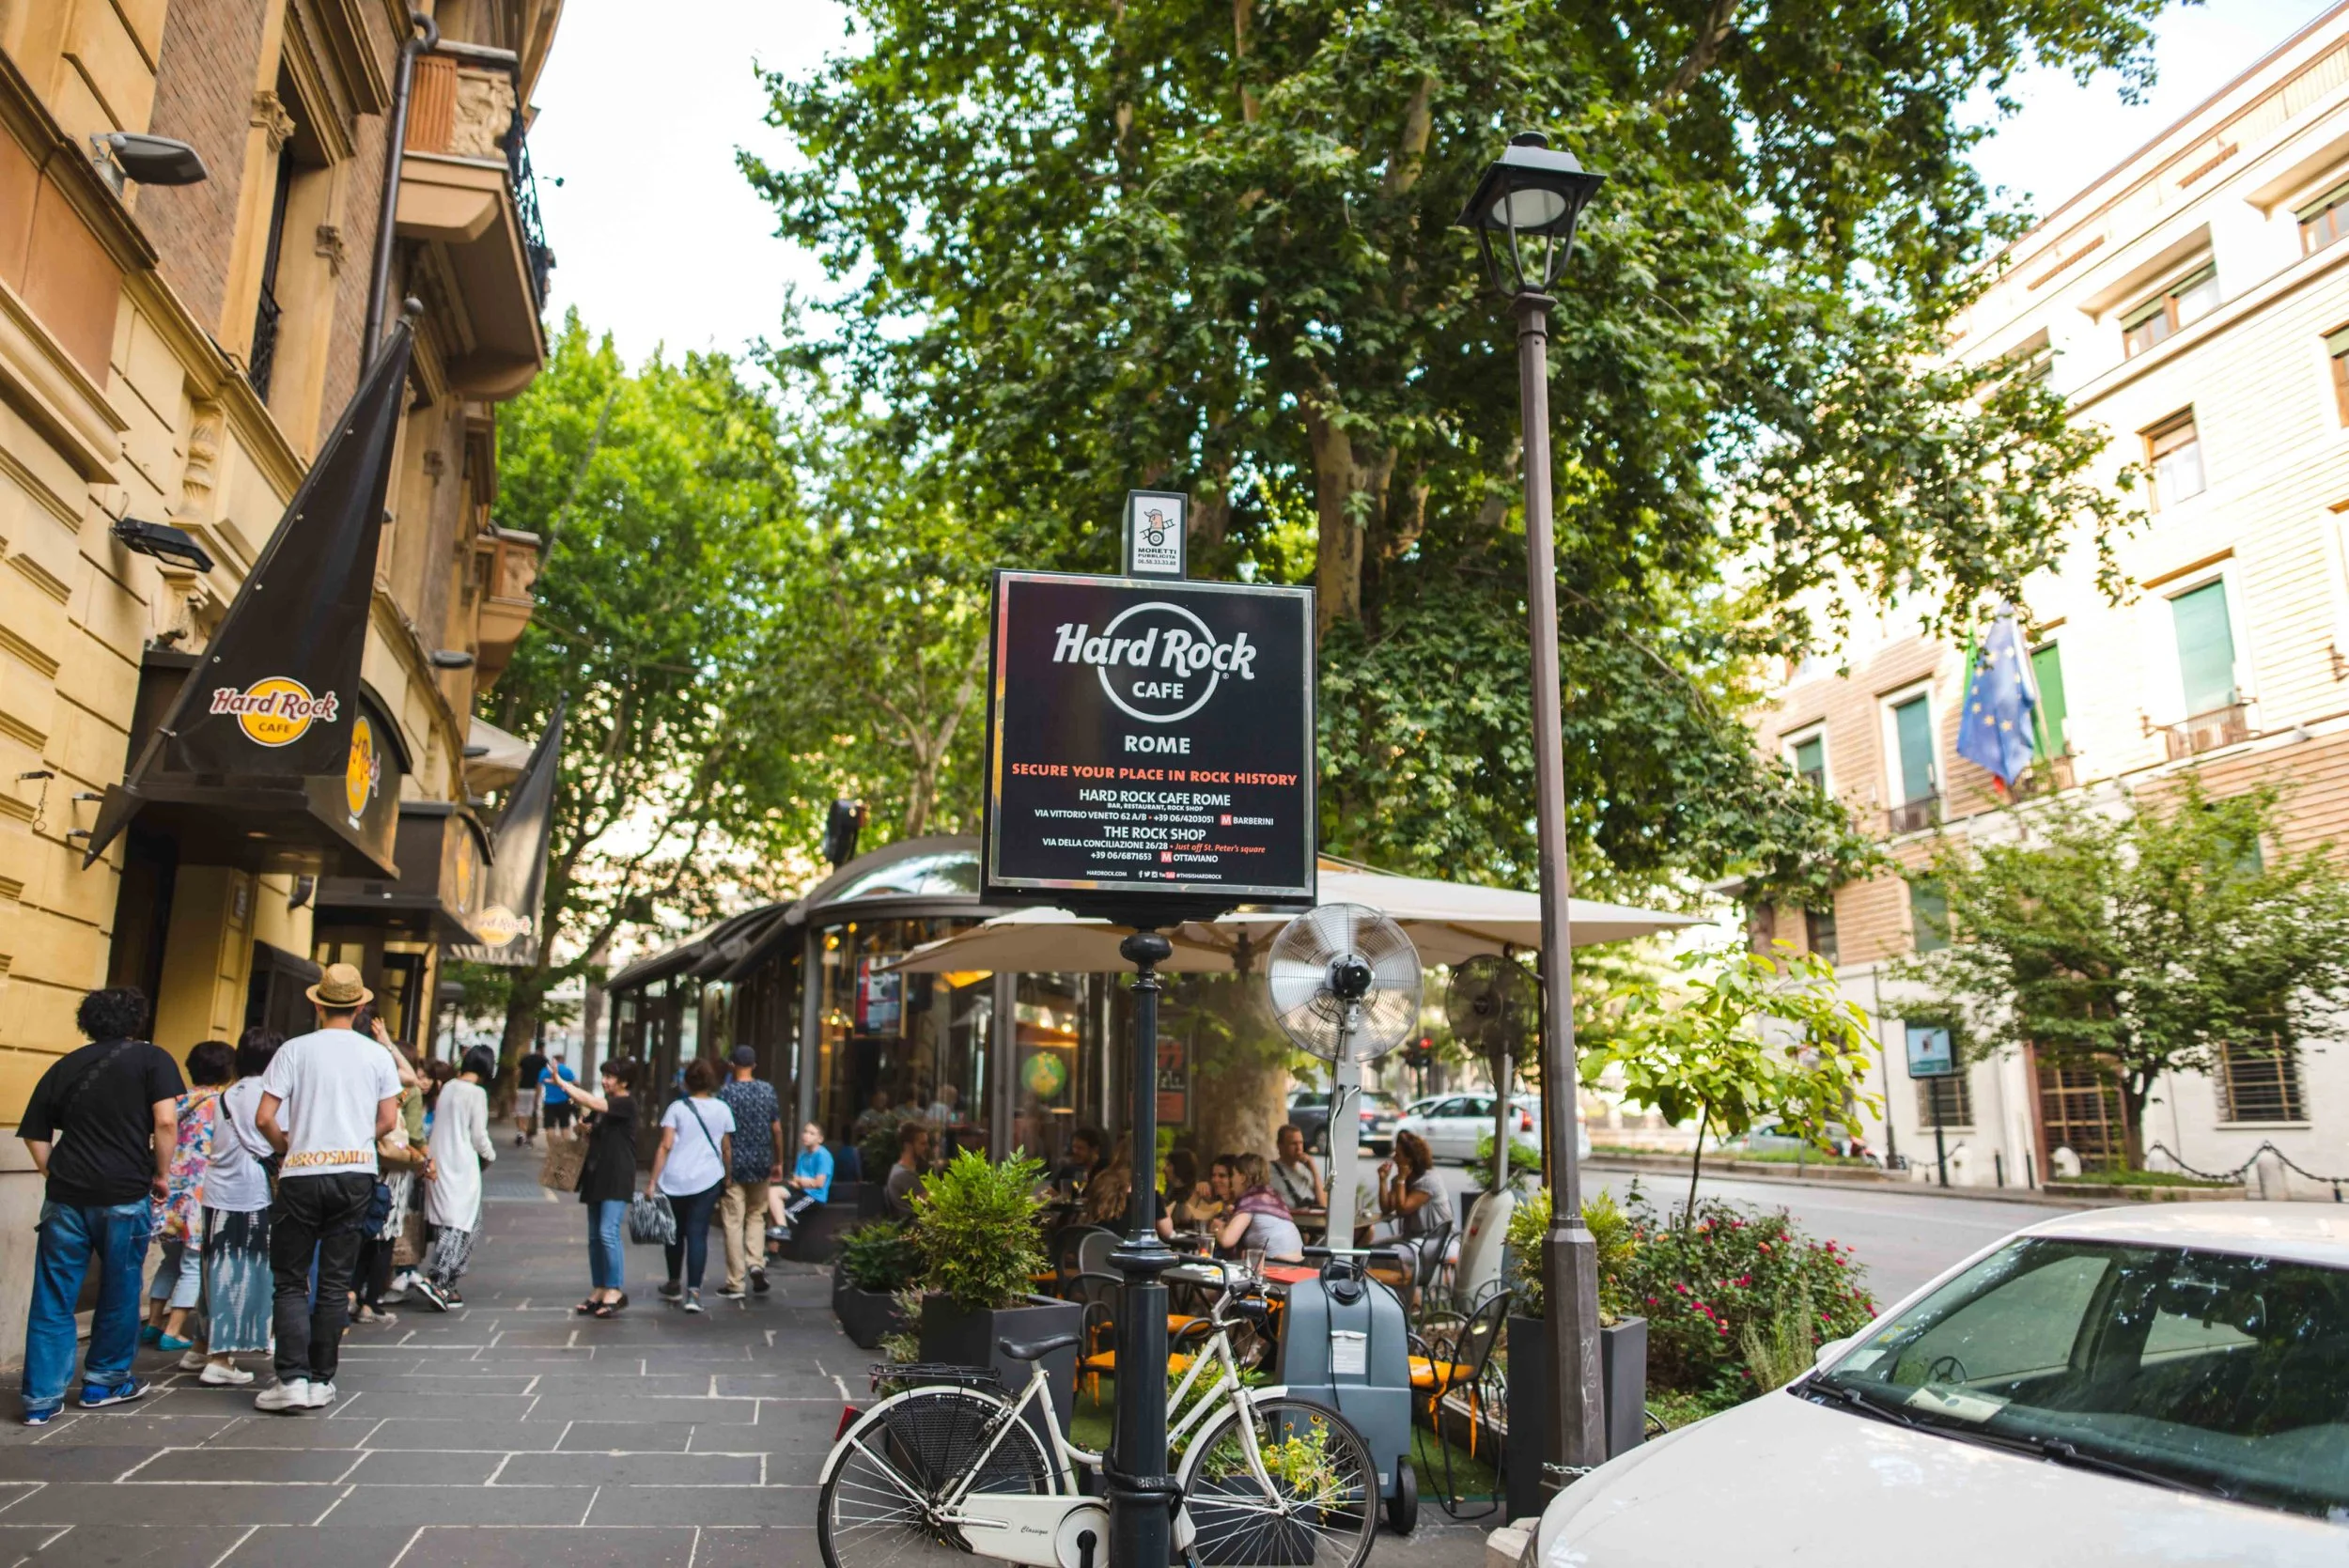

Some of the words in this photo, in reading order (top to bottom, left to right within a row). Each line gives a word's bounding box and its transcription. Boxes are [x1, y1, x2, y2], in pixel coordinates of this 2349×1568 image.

[1052, 623, 1159, 667] Hard
[1160, 629, 1257, 680] Rock
[1132, 681, 1184, 699] CAFE
[210, 688, 278, 715] Hard
[280, 691, 339, 722] Rock
[258, 722, 290, 734] CAFE
[1124, 735, 1190, 754] ROME
[1012, 763, 1068, 777] SECURE
[1072, 766, 1115, 779] YOUR
[1119, 768, 1164, 781] PLACE
[1168, 769, 1186, 782] IN
[1190, 770, 1230, 784] ROCK
[1235, 772, 1298, 786] HISTORY
[1079, 789, 1117, 801] HARD
[1120, 790, 1156, 803] ROCK
[1159, 792, 1190, 804] CAFE
[1192, 794, 1231, 806] ROME
[1034, 809, 1049, 817] VIA
[1050, 810, 1087, 819] VITTORIO
[1088, 811, 1120, 820] VENETO
[1131, 813, 1147, 822] A/B
[1154, 814, 1168, 822] +39
[1169, 815, 1214, 824] 06/4203051
[1233, 816, 1274, 826] BARBERINI
[1103, 826, 1129, 838] THE
[1132, 827, 1168, 840] ROCK
[1170, 829, 1206, 841] SHOP
[1042, 838, 1057, 846] VIA
[1058, 839, 1082, 847] DELLA
[1082, 839, 1144, 849] CONCILIAZIONE
[1144, 842, 1168, 850] 26/28
[1174, 843, 1190, 851] Just
[1191, 844, 1204, 853] off
[1214, 845, 1239, 853] Peter's
[1240, 846, 1266, 854] square
[1091, 851, 1106, 860] +39
[1107, 851, 1152, 861] 06/6871653
[1173, 854, 1219, 863] OTTAVIANO
